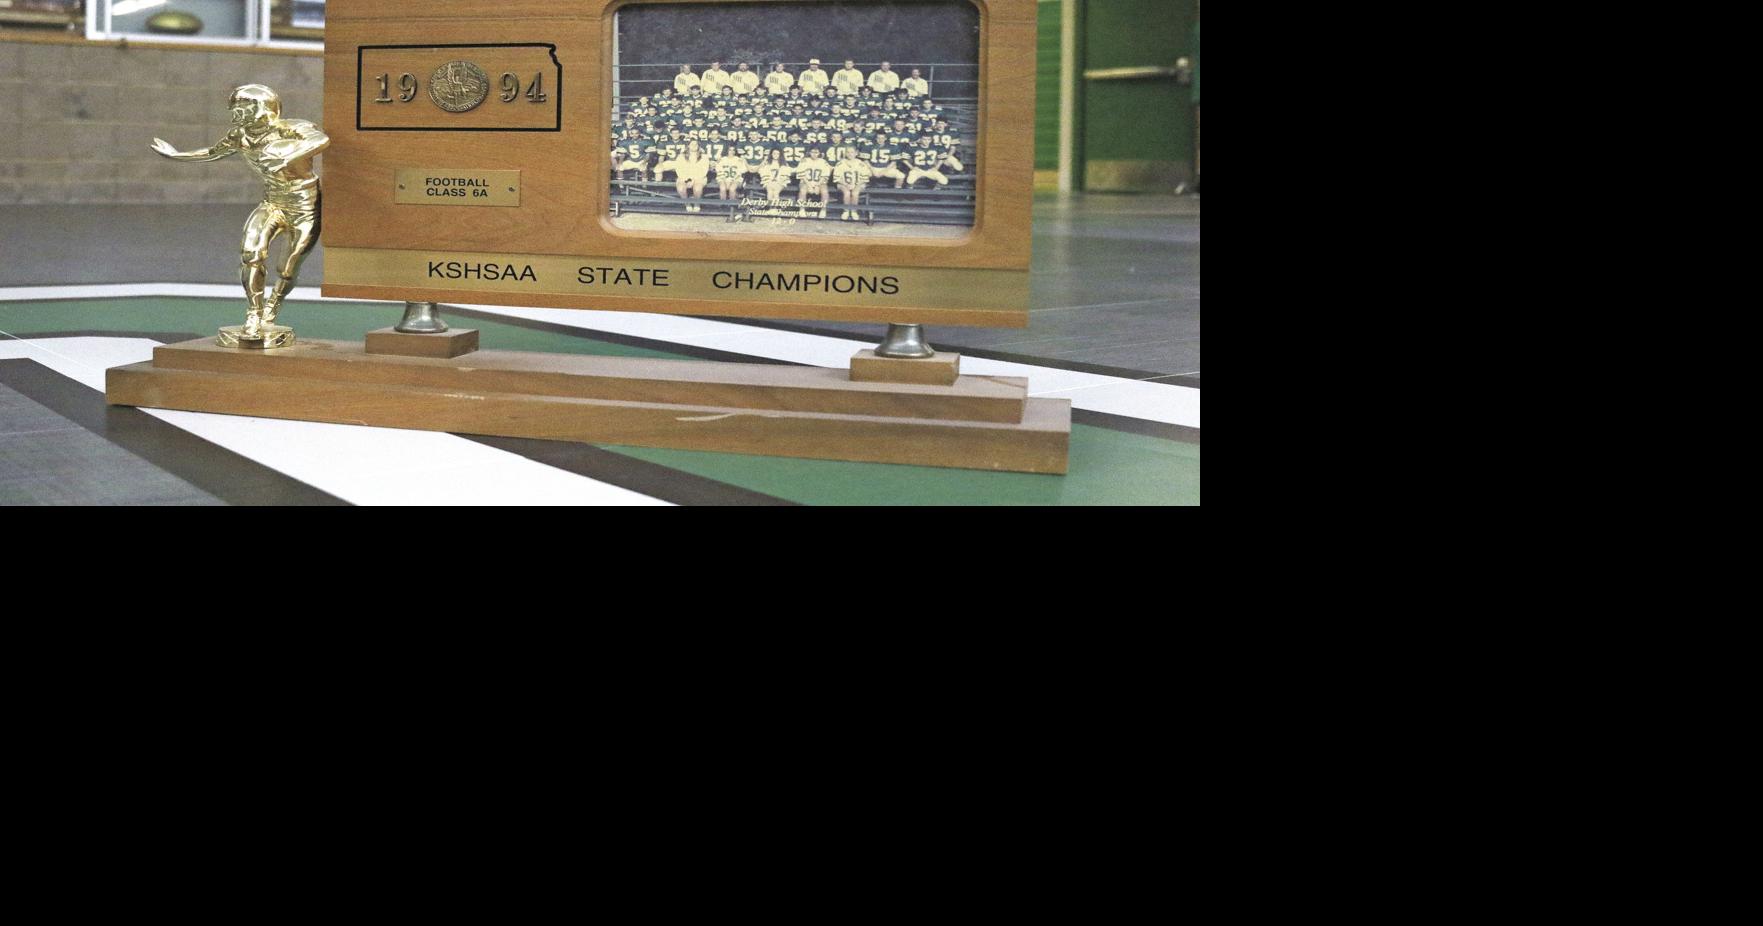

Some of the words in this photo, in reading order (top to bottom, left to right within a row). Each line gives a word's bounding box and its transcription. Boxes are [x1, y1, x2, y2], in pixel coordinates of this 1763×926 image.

[375, 72, 418, 103] 19
[500, 72, 547, 103] 94
[629, 144, 640, 159] 5
[705, 144, 724, 160] 17
[744, 145, 765, 160] 33
[783, 147, 806, 162] 25
[870, 149, 891, 163] 15
[914, 150, 938, 165] 23
[425, 177, 490, 188] FOOTBALL
[771, 168, 780, 182] 7
[844, 171, 859, 184] 61
[426, 187, 466, 197] CLASS
[472, 188, 488, 197] 6A
[740, 198, 768, 208] Derby
[771, 199, 794, 208] High
[795, 199, 827, 208] School
[428, 261, 537, 282] KSHSAA
[577, 266, 670, 287] STATE
[712, 271, 900, 295] CHAMPIONS
